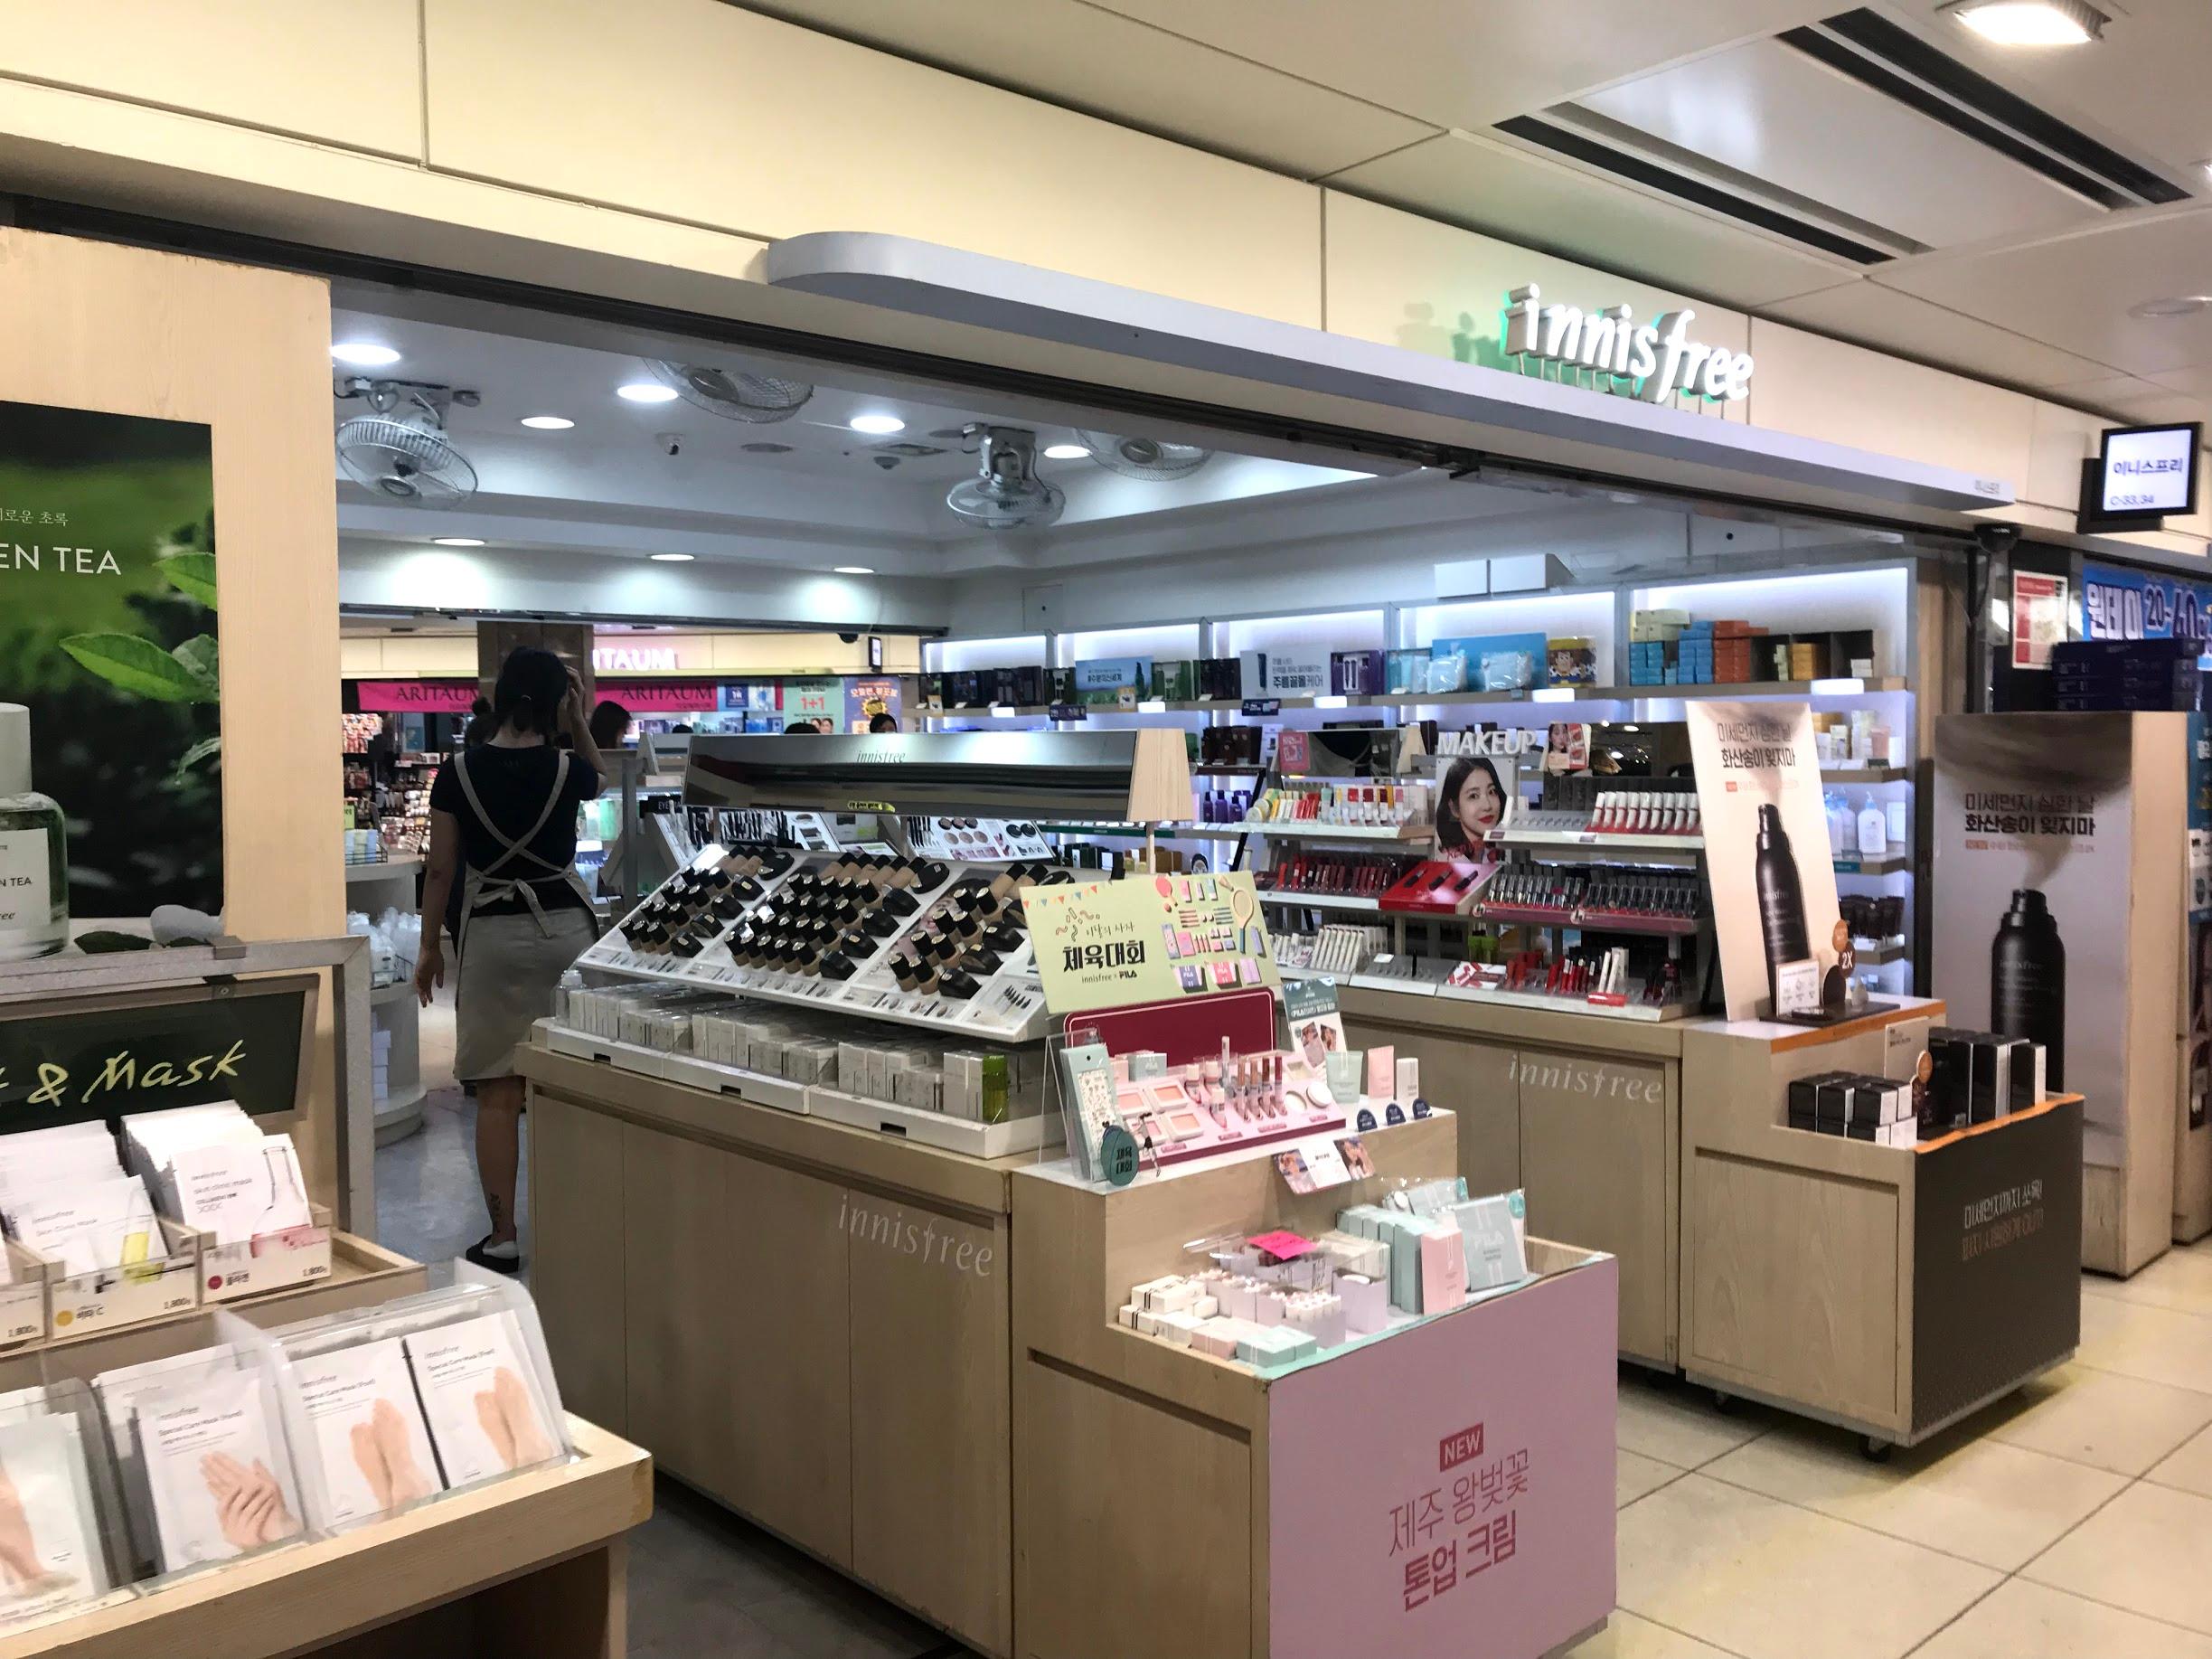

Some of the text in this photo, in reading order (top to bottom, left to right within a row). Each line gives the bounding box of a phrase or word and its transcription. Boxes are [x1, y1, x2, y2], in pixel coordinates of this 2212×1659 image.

[1505, 283, 1754, 404] innisfree
[2113, 457, 2183, 476] 이니스프리
[39, 512, 69, 526] 초록
[53, 547, 121, 575] TEA
[621, 685, 712, 701] ARITAUM
[800, 696, 825, 710] 1+1
[1436, 728, 1537, 755] MAKEUP
[1721, 747, 1796, 768] 화산송이 잊지마
[1965, 793, 2095, 815] 미세먼지 심한 날
[1964, 814, 2095, 836] 화산송이 잊지마
[10, 877, 32, 886] TEA
[1062, 940, 1145, 973] 체육대회
[1841, 953, 1853, 970] 2X
[1081, 974, 1113, 984] innisfree
[1119, 970, 1137, 980] FILA
[27, 1062, 69, 1107] &
[80, 1040, 247, 1104] Mask
[1509, 1053, 1661, 1104] innisfree
[838, 1194, 993, 1277] innisfree
[1445, 1431, 1481, 1465] NEW
[1388, 1447, 1529, 1558] 제주 왕벚꽃
[1403, 1509, 1517, 1613] 톤업 크림
